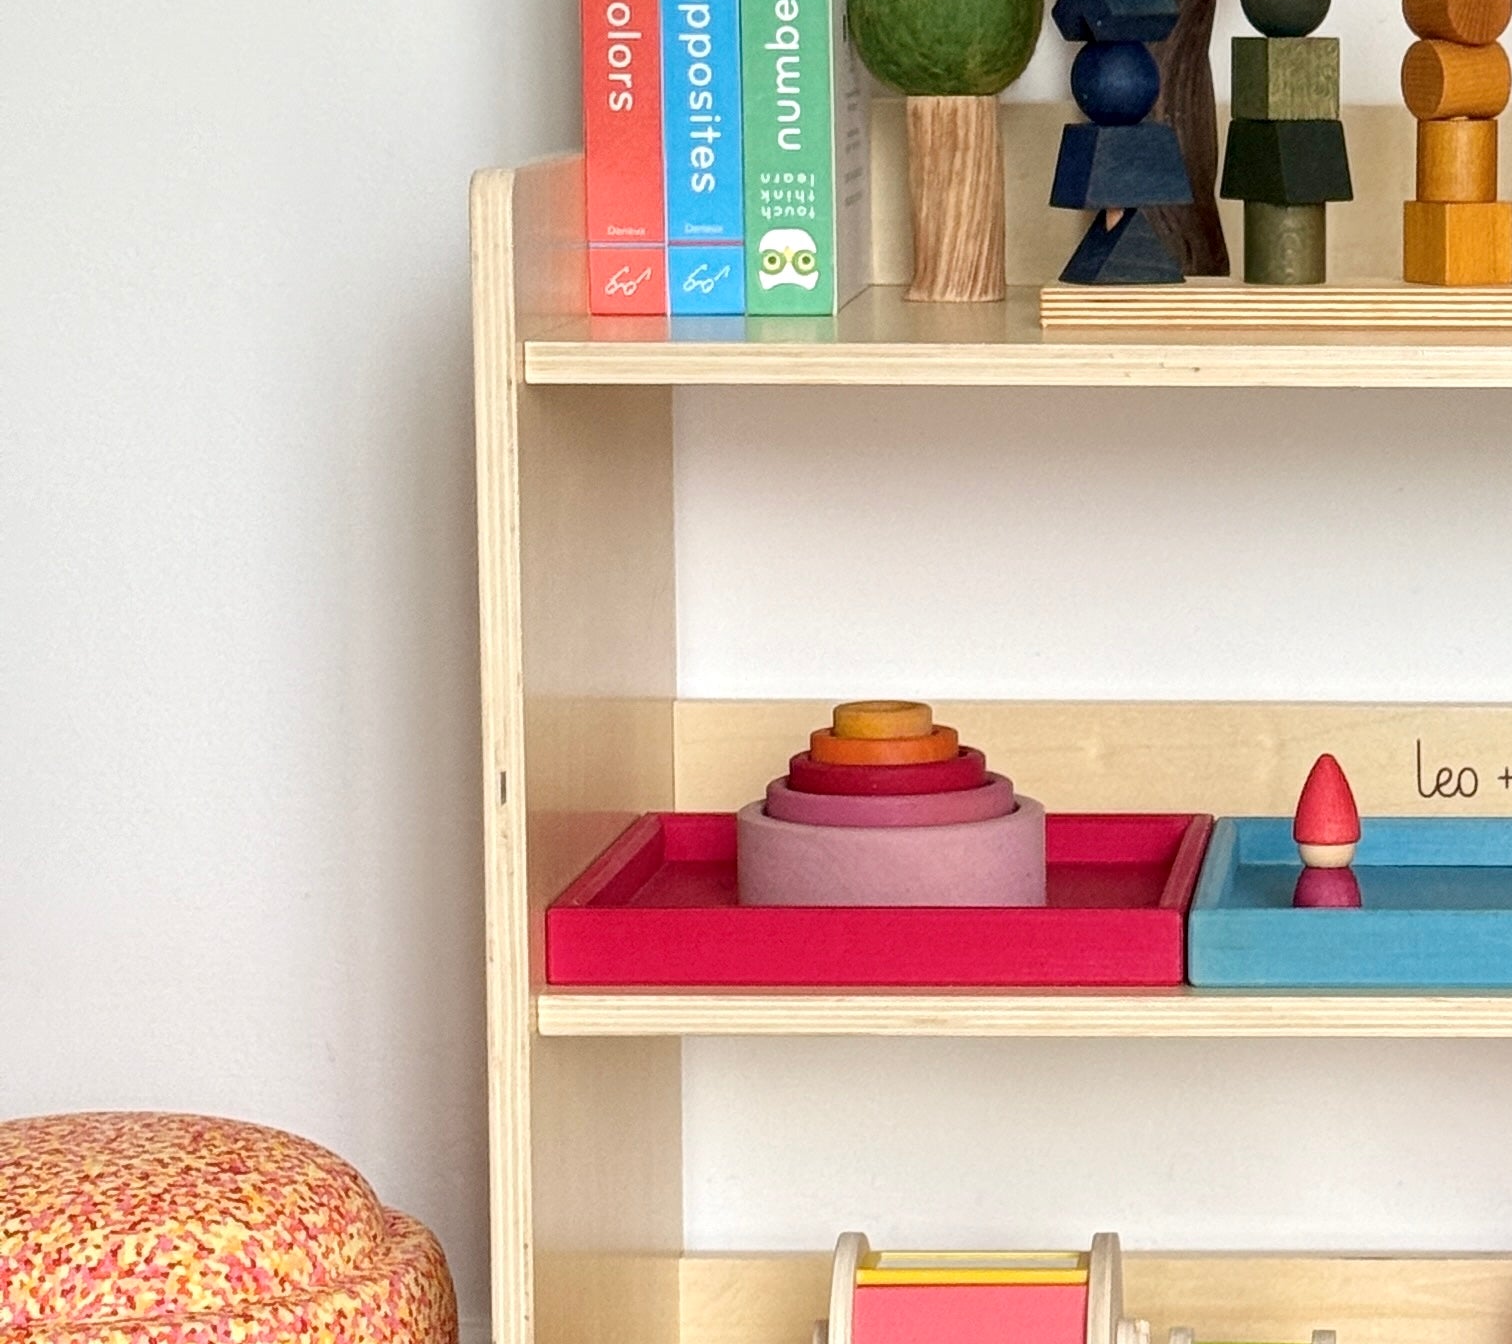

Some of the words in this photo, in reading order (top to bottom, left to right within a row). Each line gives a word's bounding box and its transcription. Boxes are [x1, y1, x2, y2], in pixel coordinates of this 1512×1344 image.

[760, 173, 814, 187] learn
[760, 190, 815, 203] think
[761, 206, 815, 219] touch
[1416, 739, 1479, 798] leo
